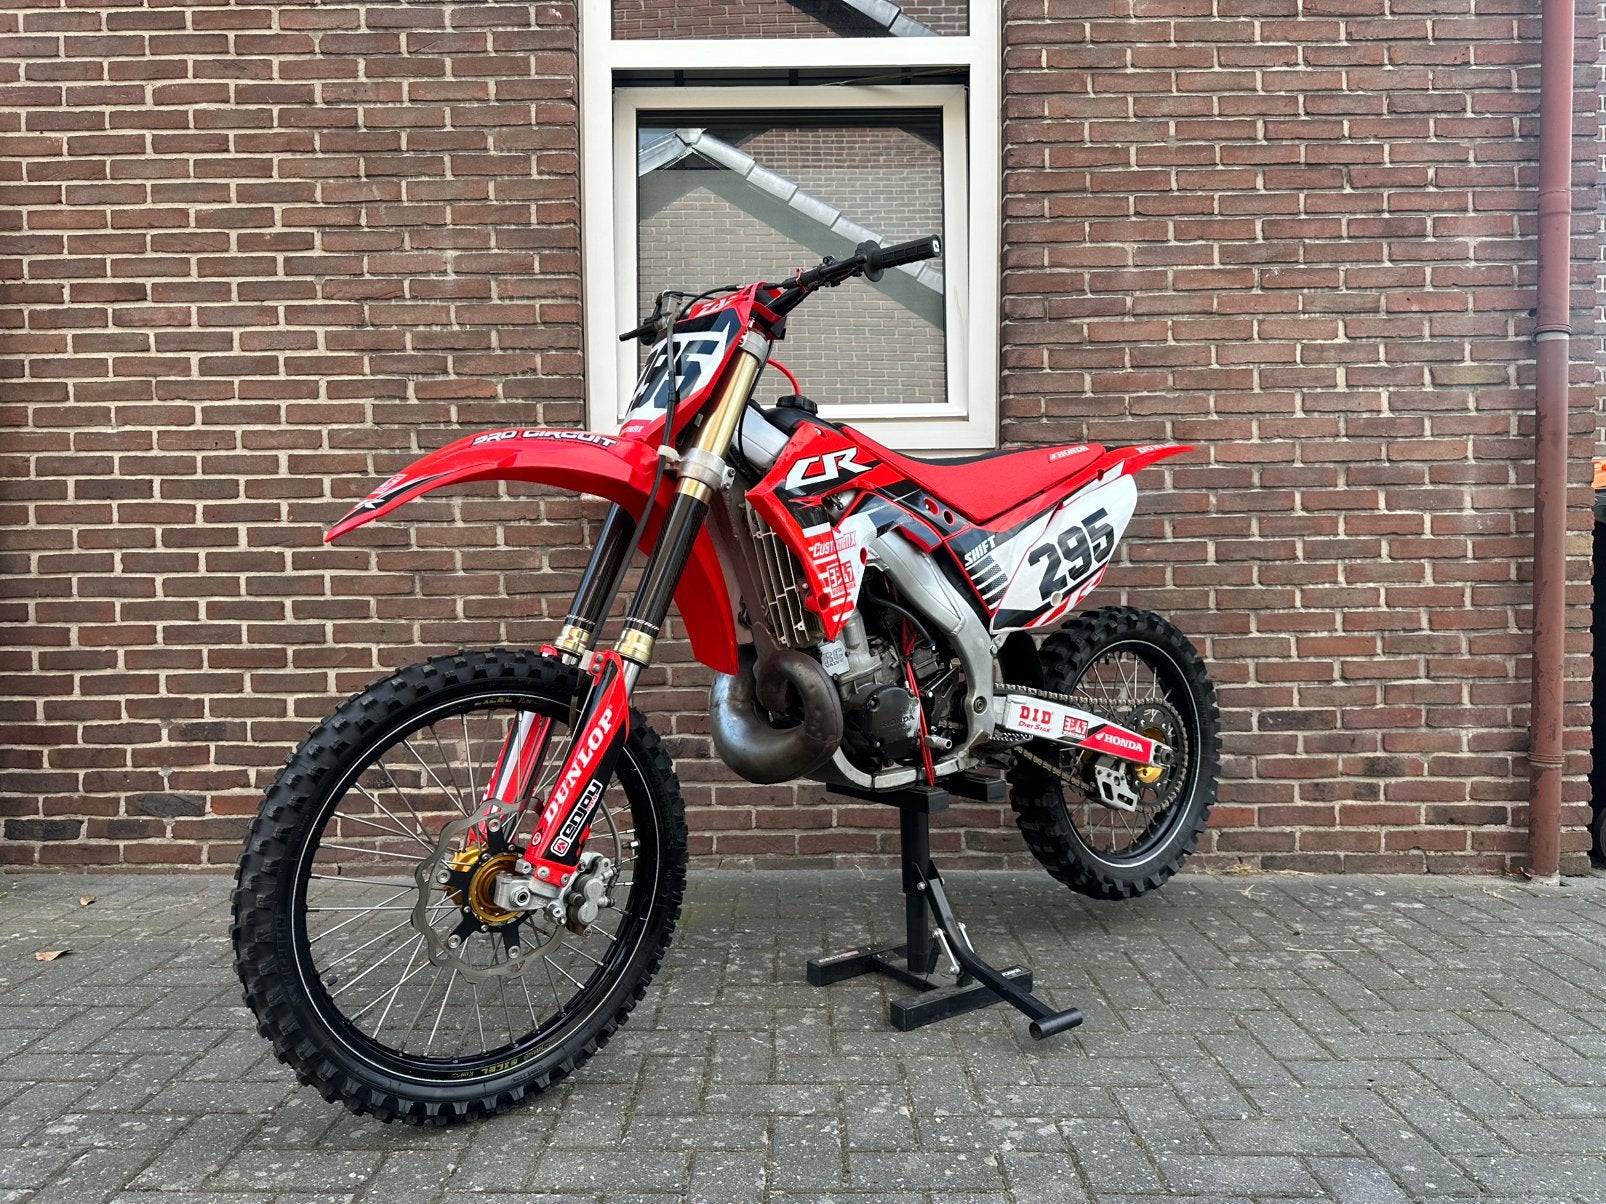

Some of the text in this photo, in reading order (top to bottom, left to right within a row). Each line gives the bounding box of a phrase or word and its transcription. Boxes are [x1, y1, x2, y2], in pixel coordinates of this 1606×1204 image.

[521, 430, 618, 447] CIRCUIT
[1056, 444, 1090, 459] HONDA
[784, 446, 873, 491] CR
[963, 534, 996, 568] SHIFT
[1027, 506, 1115, 602] 295
[824, 647, 844, 665] RC
[1019, 705, 1052, 725] D.I.D
[1103, 733, 1144, 753] HONDA
[543, 707, 614, 827] DUNLOP
[562, 781, 602, 839] enjoy
[481, 1058, 518, 1075] EXCEL
